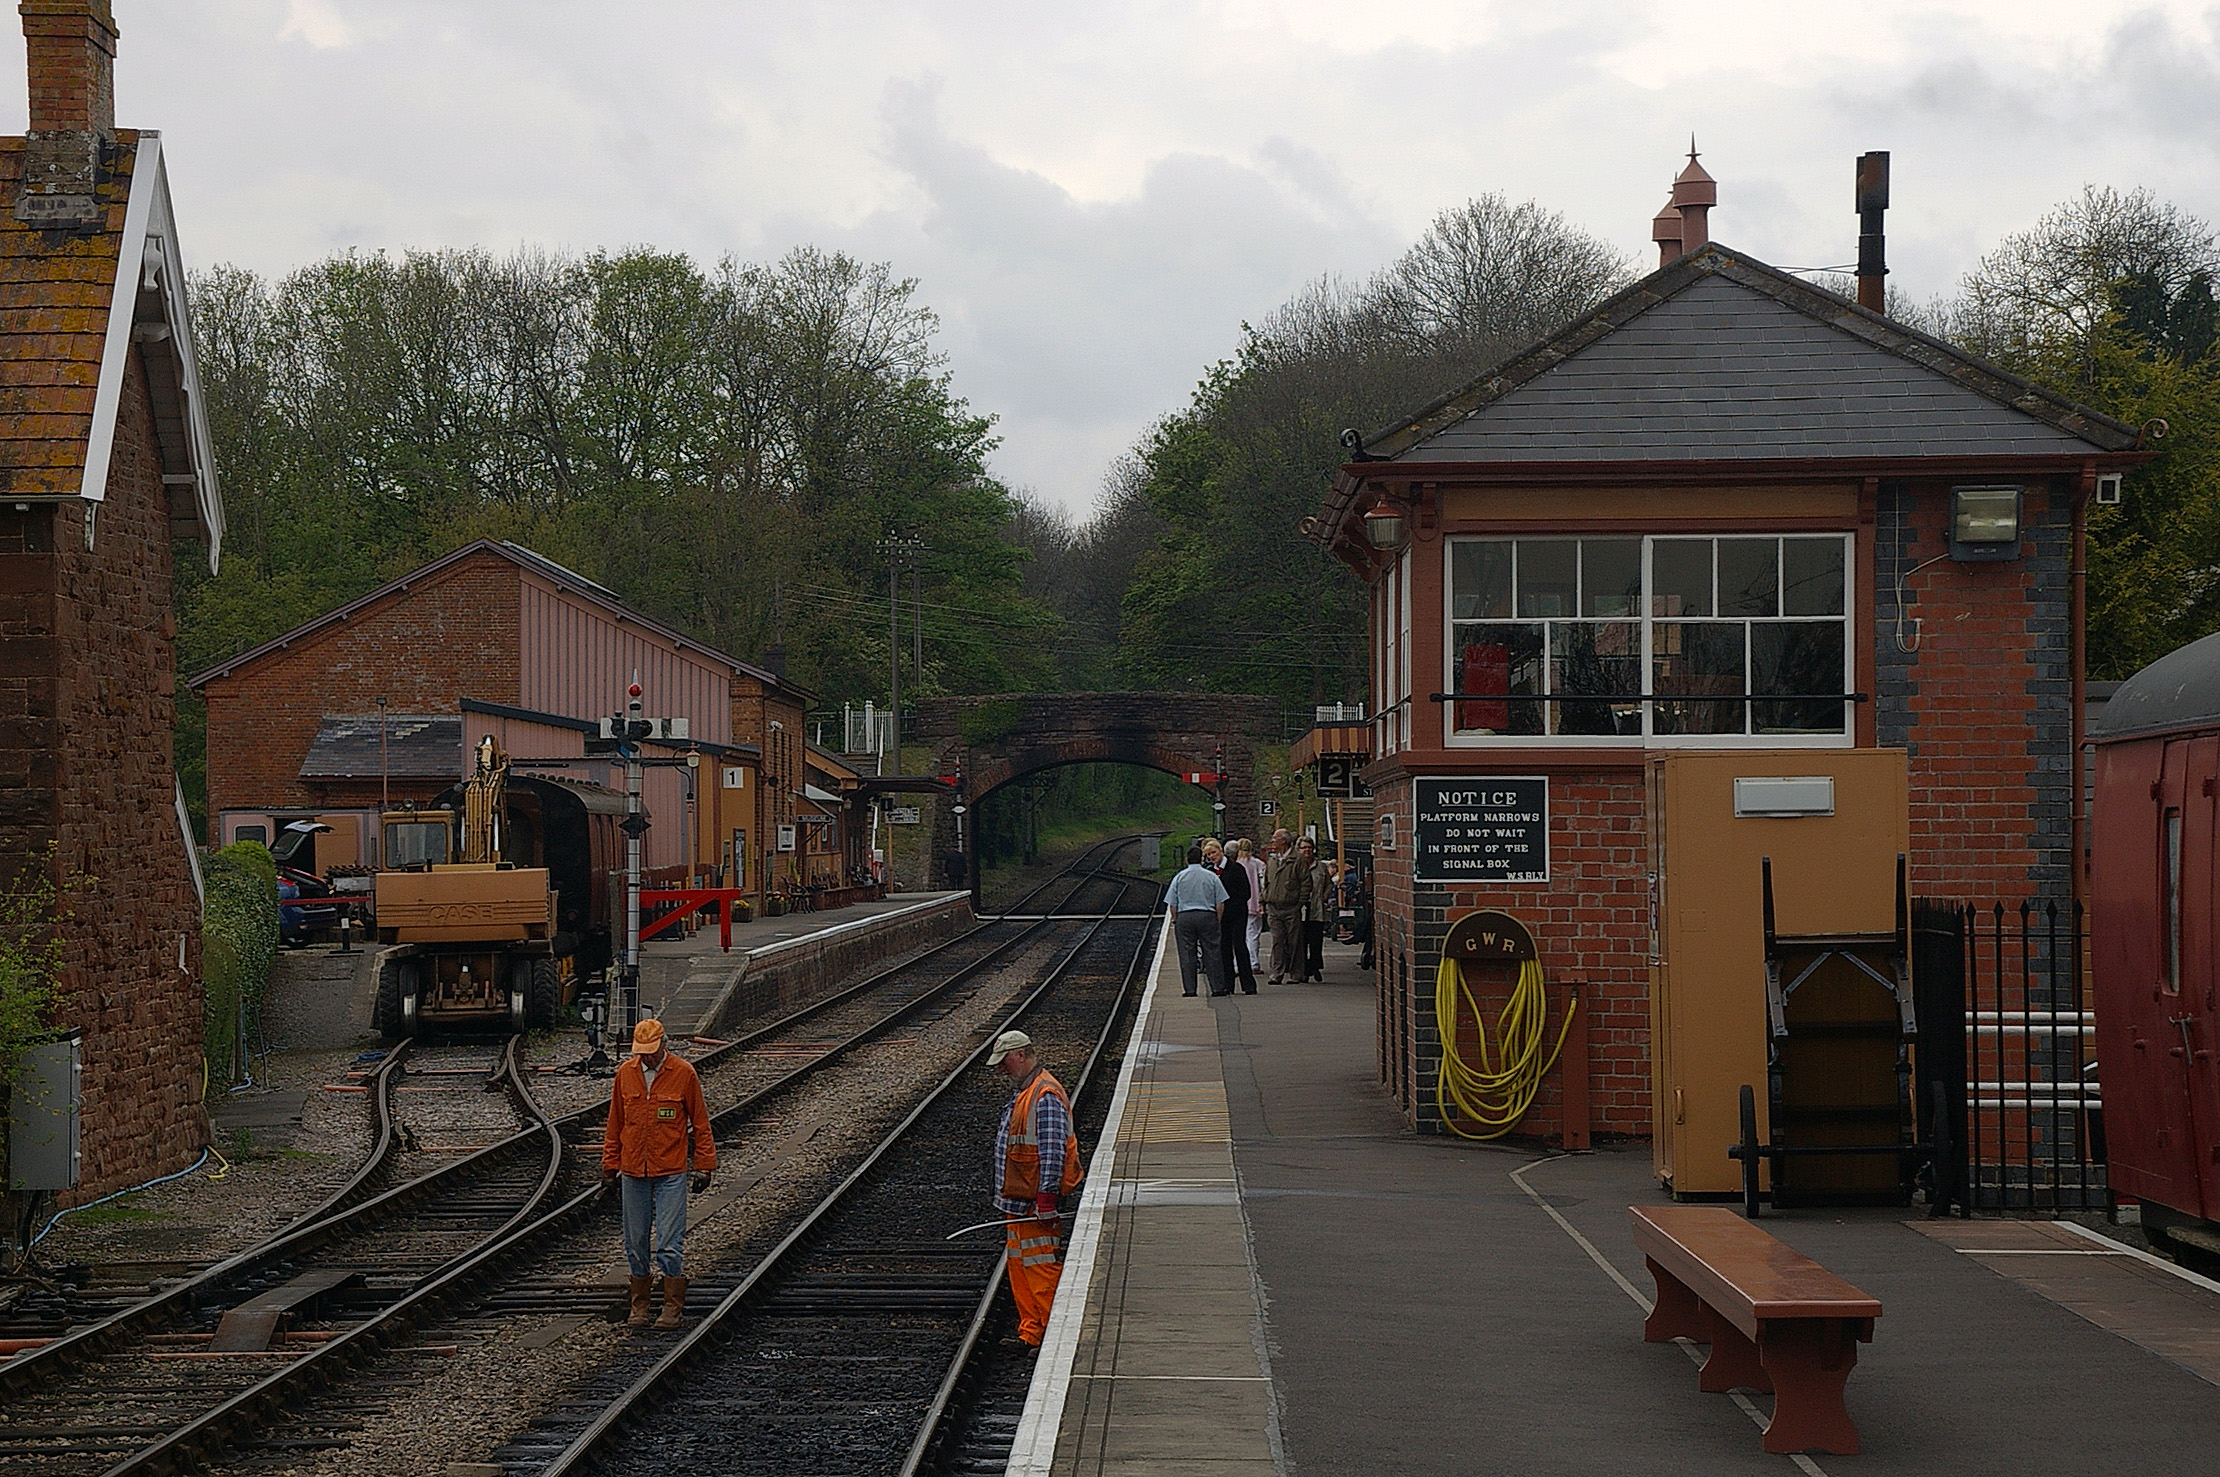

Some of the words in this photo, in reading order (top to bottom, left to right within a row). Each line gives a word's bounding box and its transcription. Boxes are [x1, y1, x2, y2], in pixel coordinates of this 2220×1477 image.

[729, 771, 735, 785] 1
[1328, 763, 1343, 784] 2
[1438, 792, 1517, 805] NOTICE
[1264, 804, 1271, 813] 2
[1420, 813, 1478, 822] PLATFORM
[1484, 813, 1540, 822] NARROWS
[1446, 829, 1460, 837] DO
[1467, 829, 1490, 837] NOT
[1495, 829, 1526, 837] WAIT
[1428, 845, 1439, 853] IN
[1444, 845, 1479, 853] FRONT
[1485, 845, 1500, 853] OF
[1505, 845, 1529, 853] THE
[1443, 860, 1484, 869] SIGNAL
[1487, 860, 1510, 869] BOX
[429, 905, 492, 920] CASE
[1465, 932, 1516, 953] GWR
